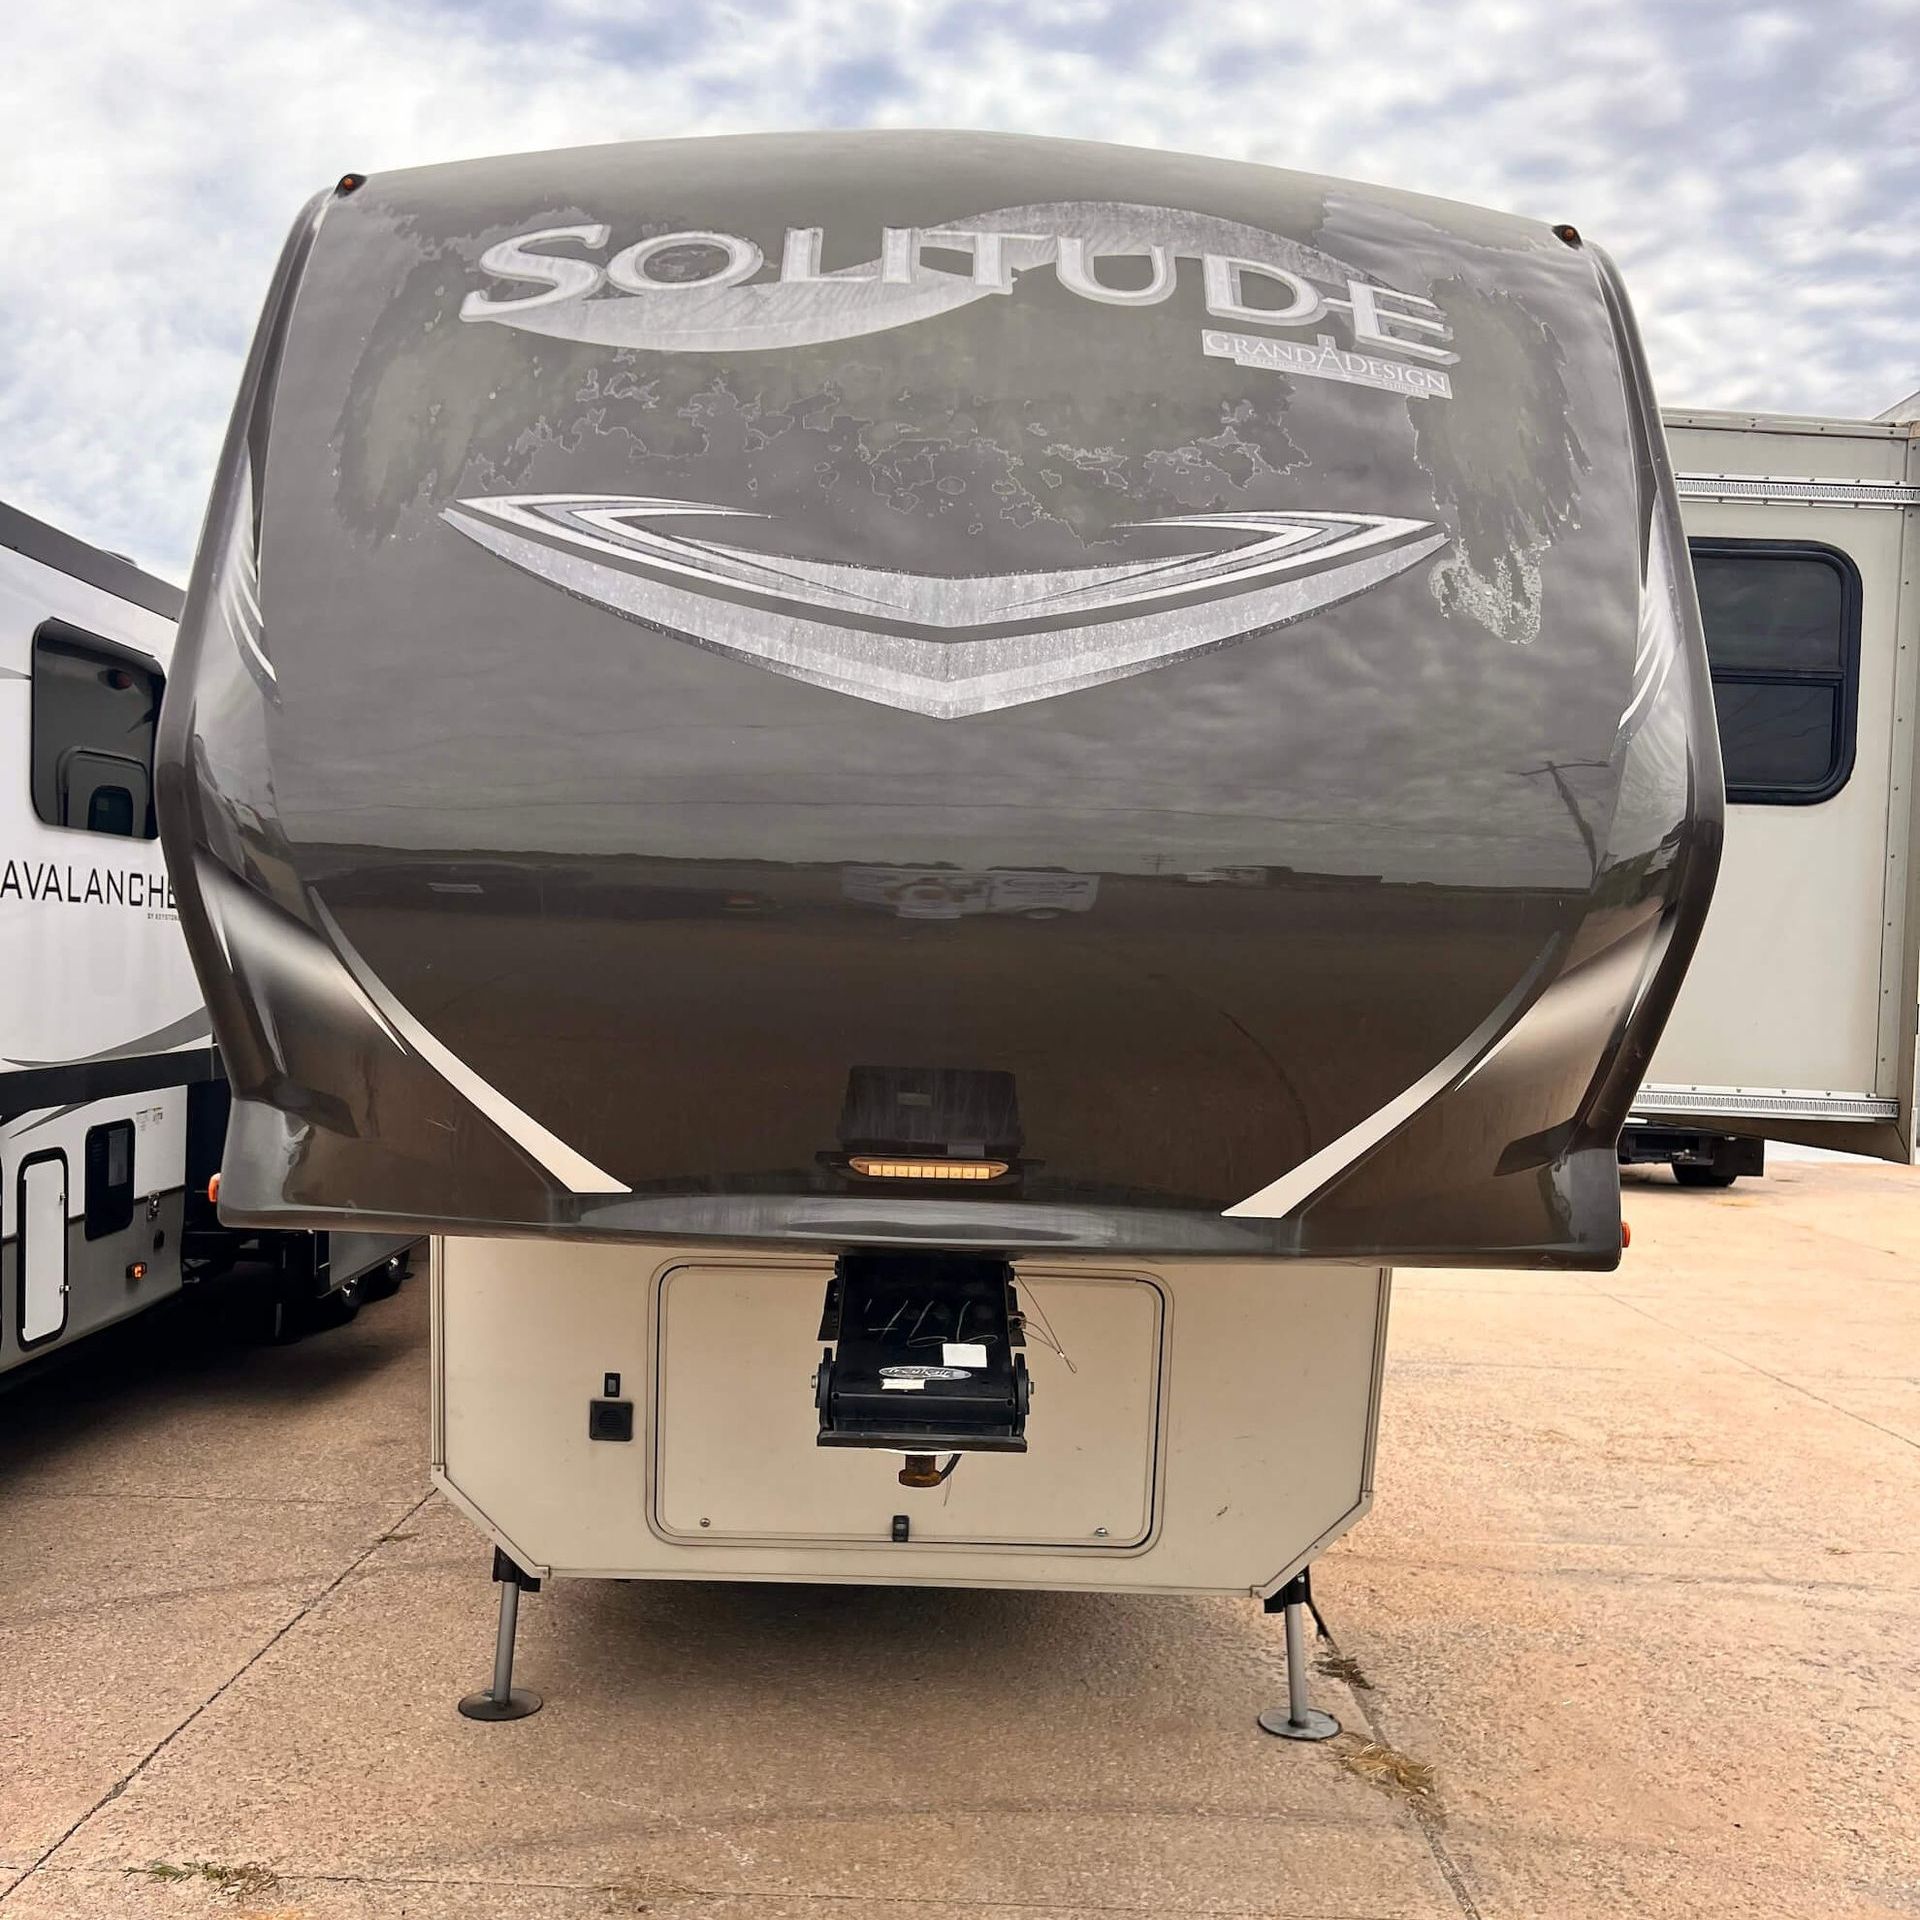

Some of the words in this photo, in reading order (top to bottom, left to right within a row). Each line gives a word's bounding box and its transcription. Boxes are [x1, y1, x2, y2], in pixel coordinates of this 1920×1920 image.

[459, 222, 1460, 362] SOLITUDE
[1205, 332, 1317, 364] GRAND
[1345, 352, 1448, 394] DESIGN
